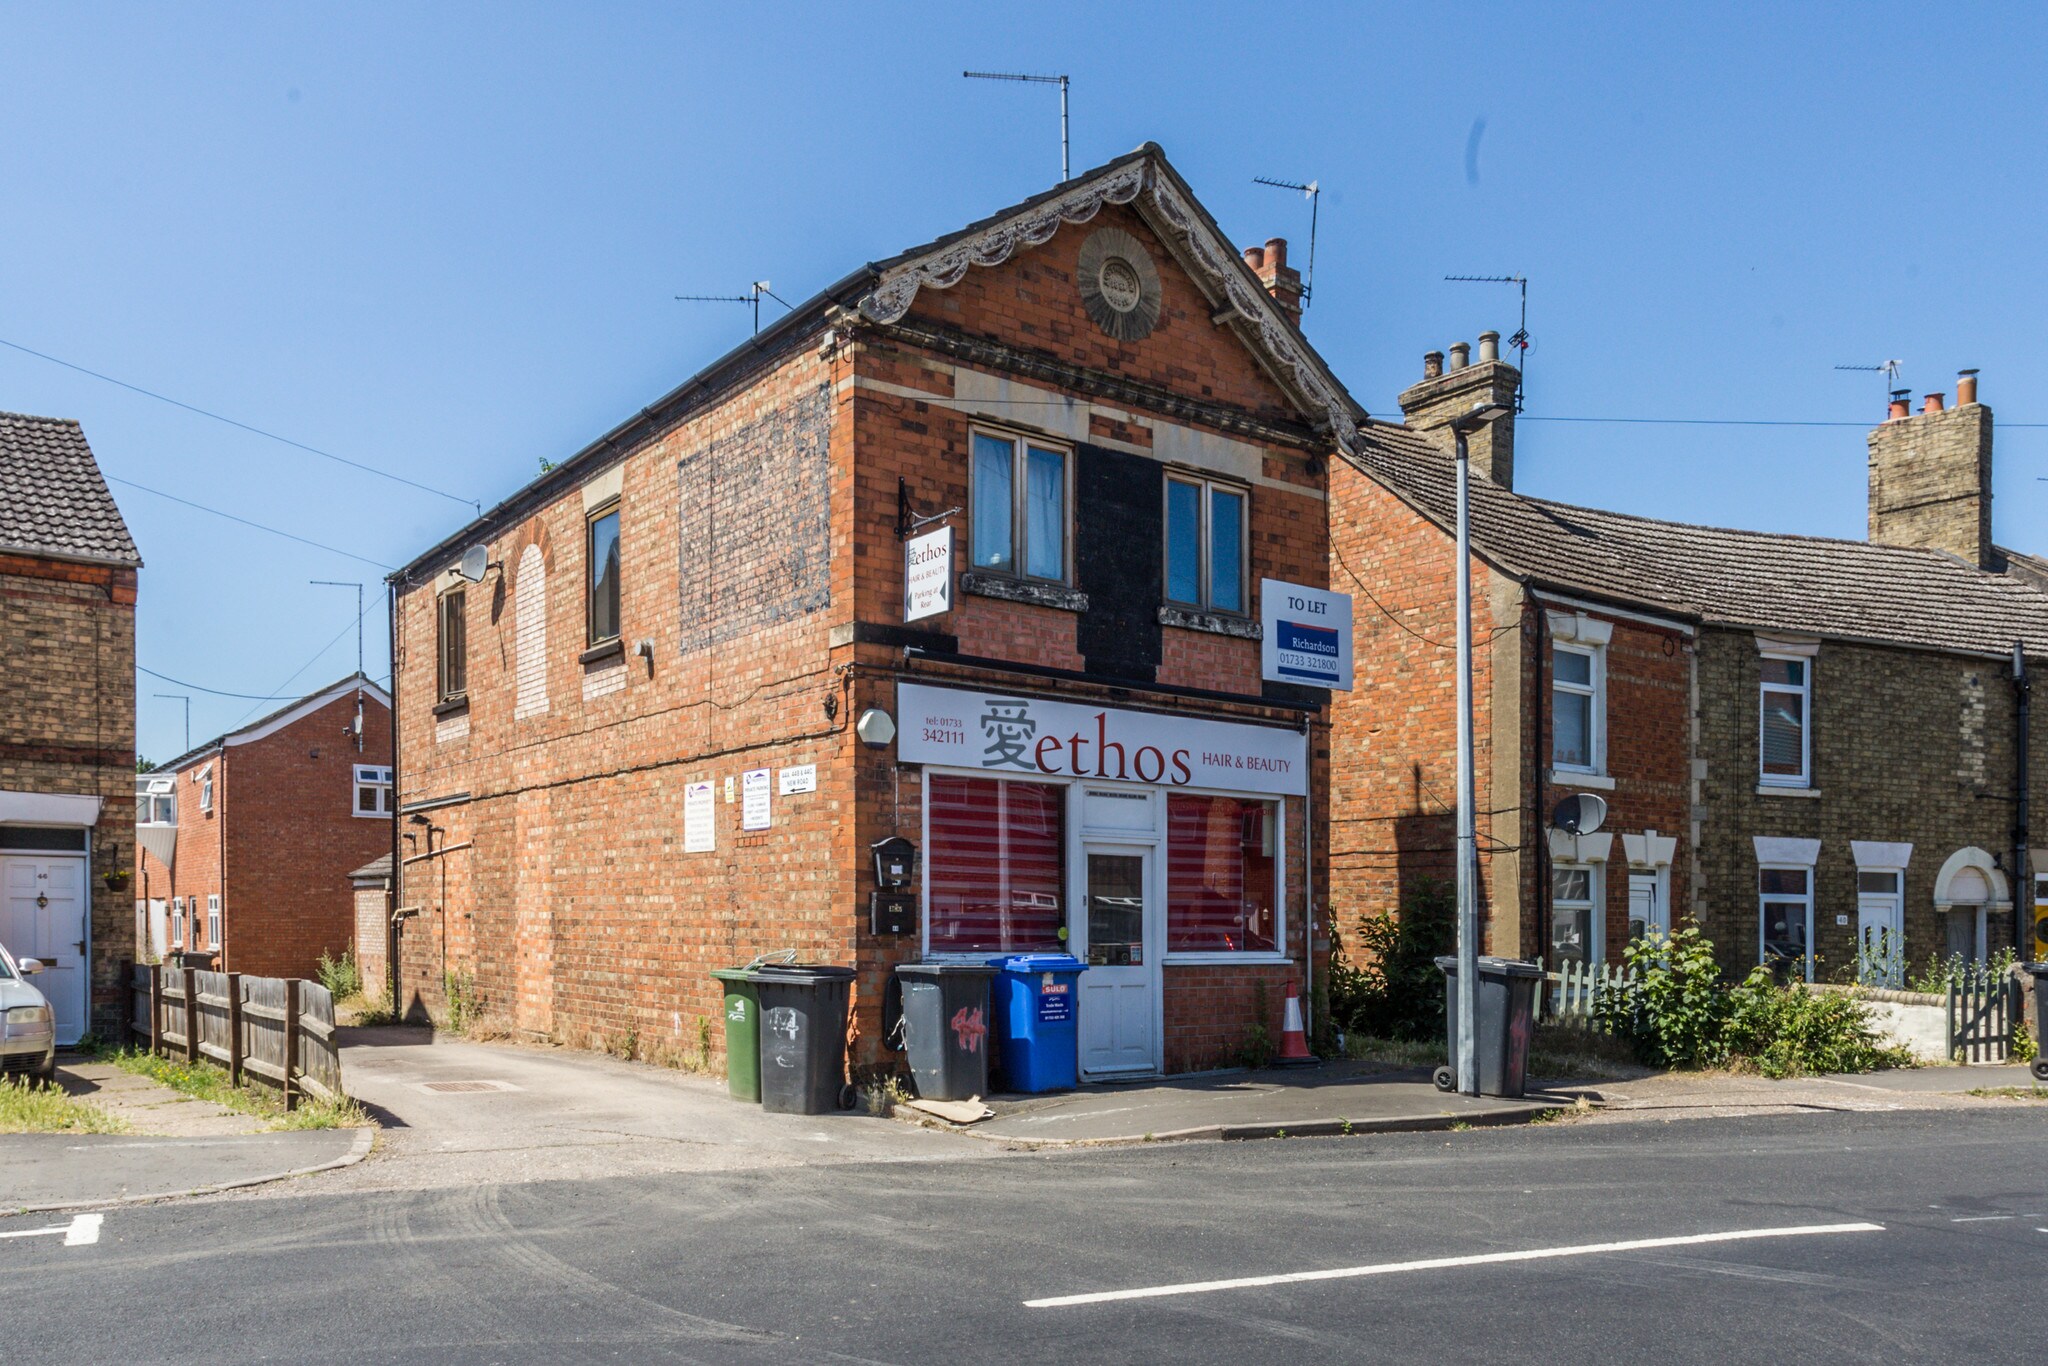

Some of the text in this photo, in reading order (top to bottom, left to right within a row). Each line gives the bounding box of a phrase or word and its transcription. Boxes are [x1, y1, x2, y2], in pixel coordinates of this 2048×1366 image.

[916, 543, 947, 564] ethos
[926, 566, 946, 578] BEAUTY
[914, 588, 932, 600] Parking
[920, 600, 932, 608] Rear
[1288, 596, 1328, 615] TO LET
[1292, 637, 1336, 653] Richardson
[1280, 653, 1337, 671] 01733 321800
[926, 716, 963, 729] tel: 01733
[922, 728, 965, 745] 342111
[981, 700, 1037, 770] 愛
[1035, 711, 1192, 786] ethos
[1202, 752, 1292, 774] HAIR & BEAUTY
